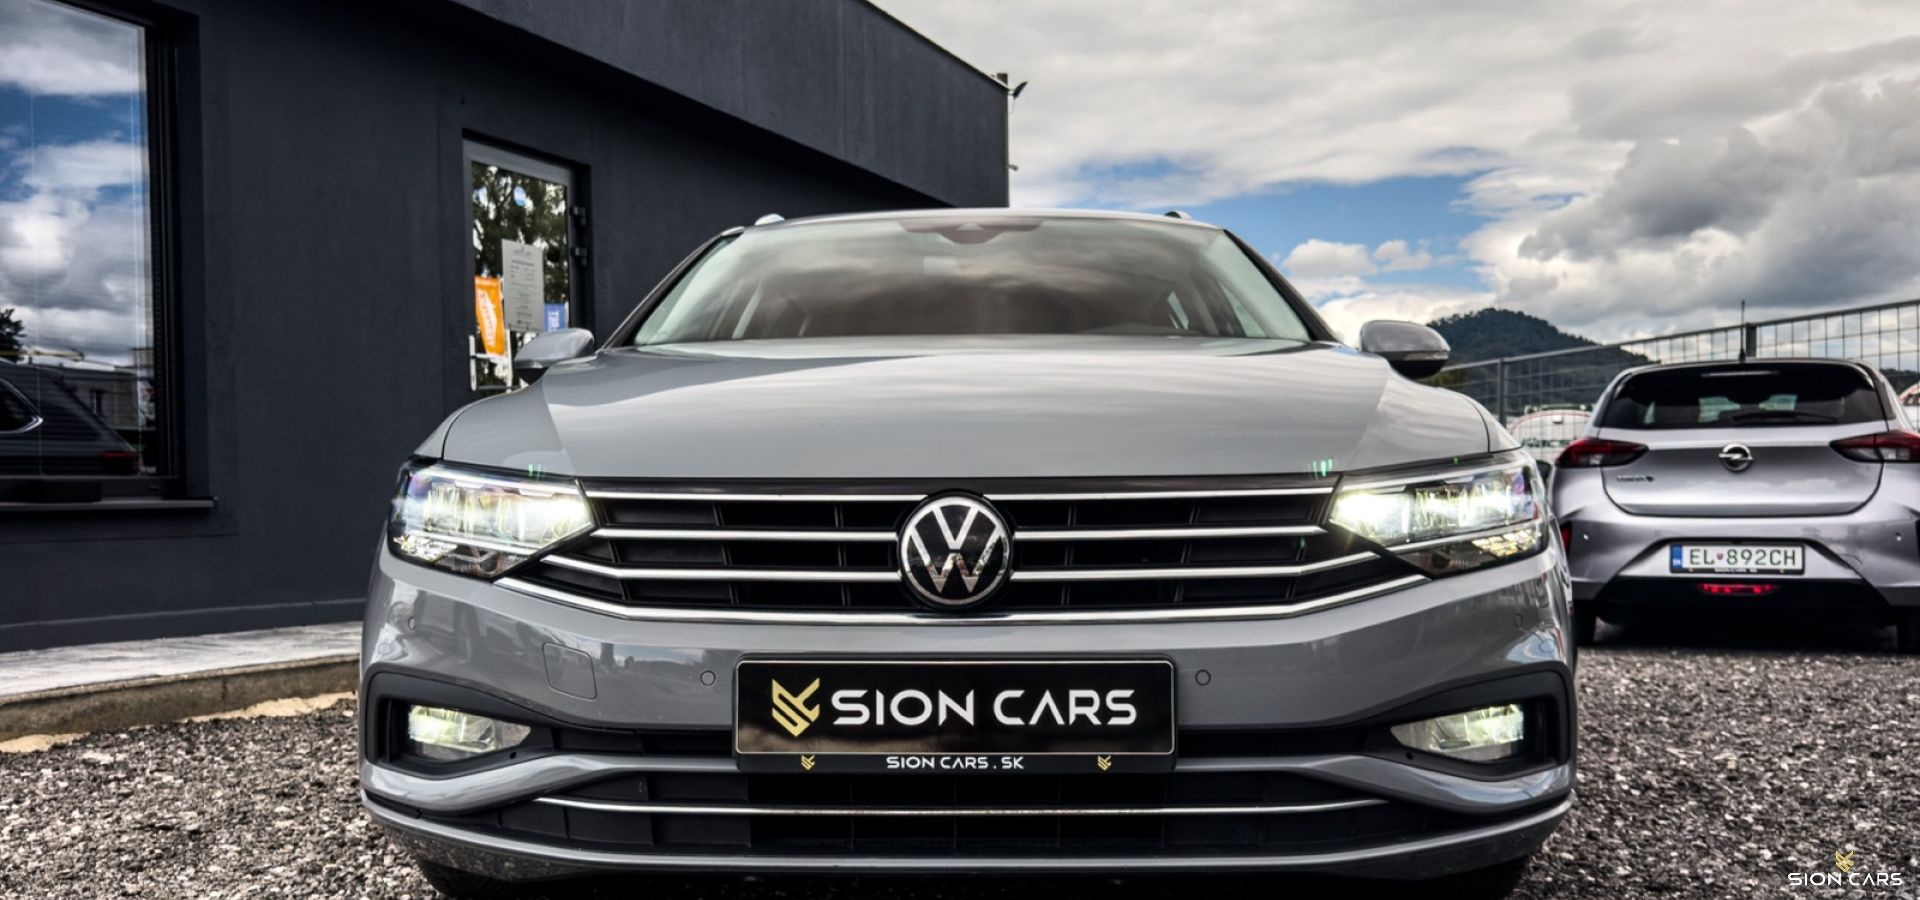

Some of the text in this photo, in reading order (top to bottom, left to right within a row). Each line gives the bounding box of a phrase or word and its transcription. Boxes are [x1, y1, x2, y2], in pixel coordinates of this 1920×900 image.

[831, 688, 1138, 726] SION CARS
[886, 755, 935, 770] SION
[940, 755, 989, 770] CARS
[1001, 755, 1025, 770] SK
